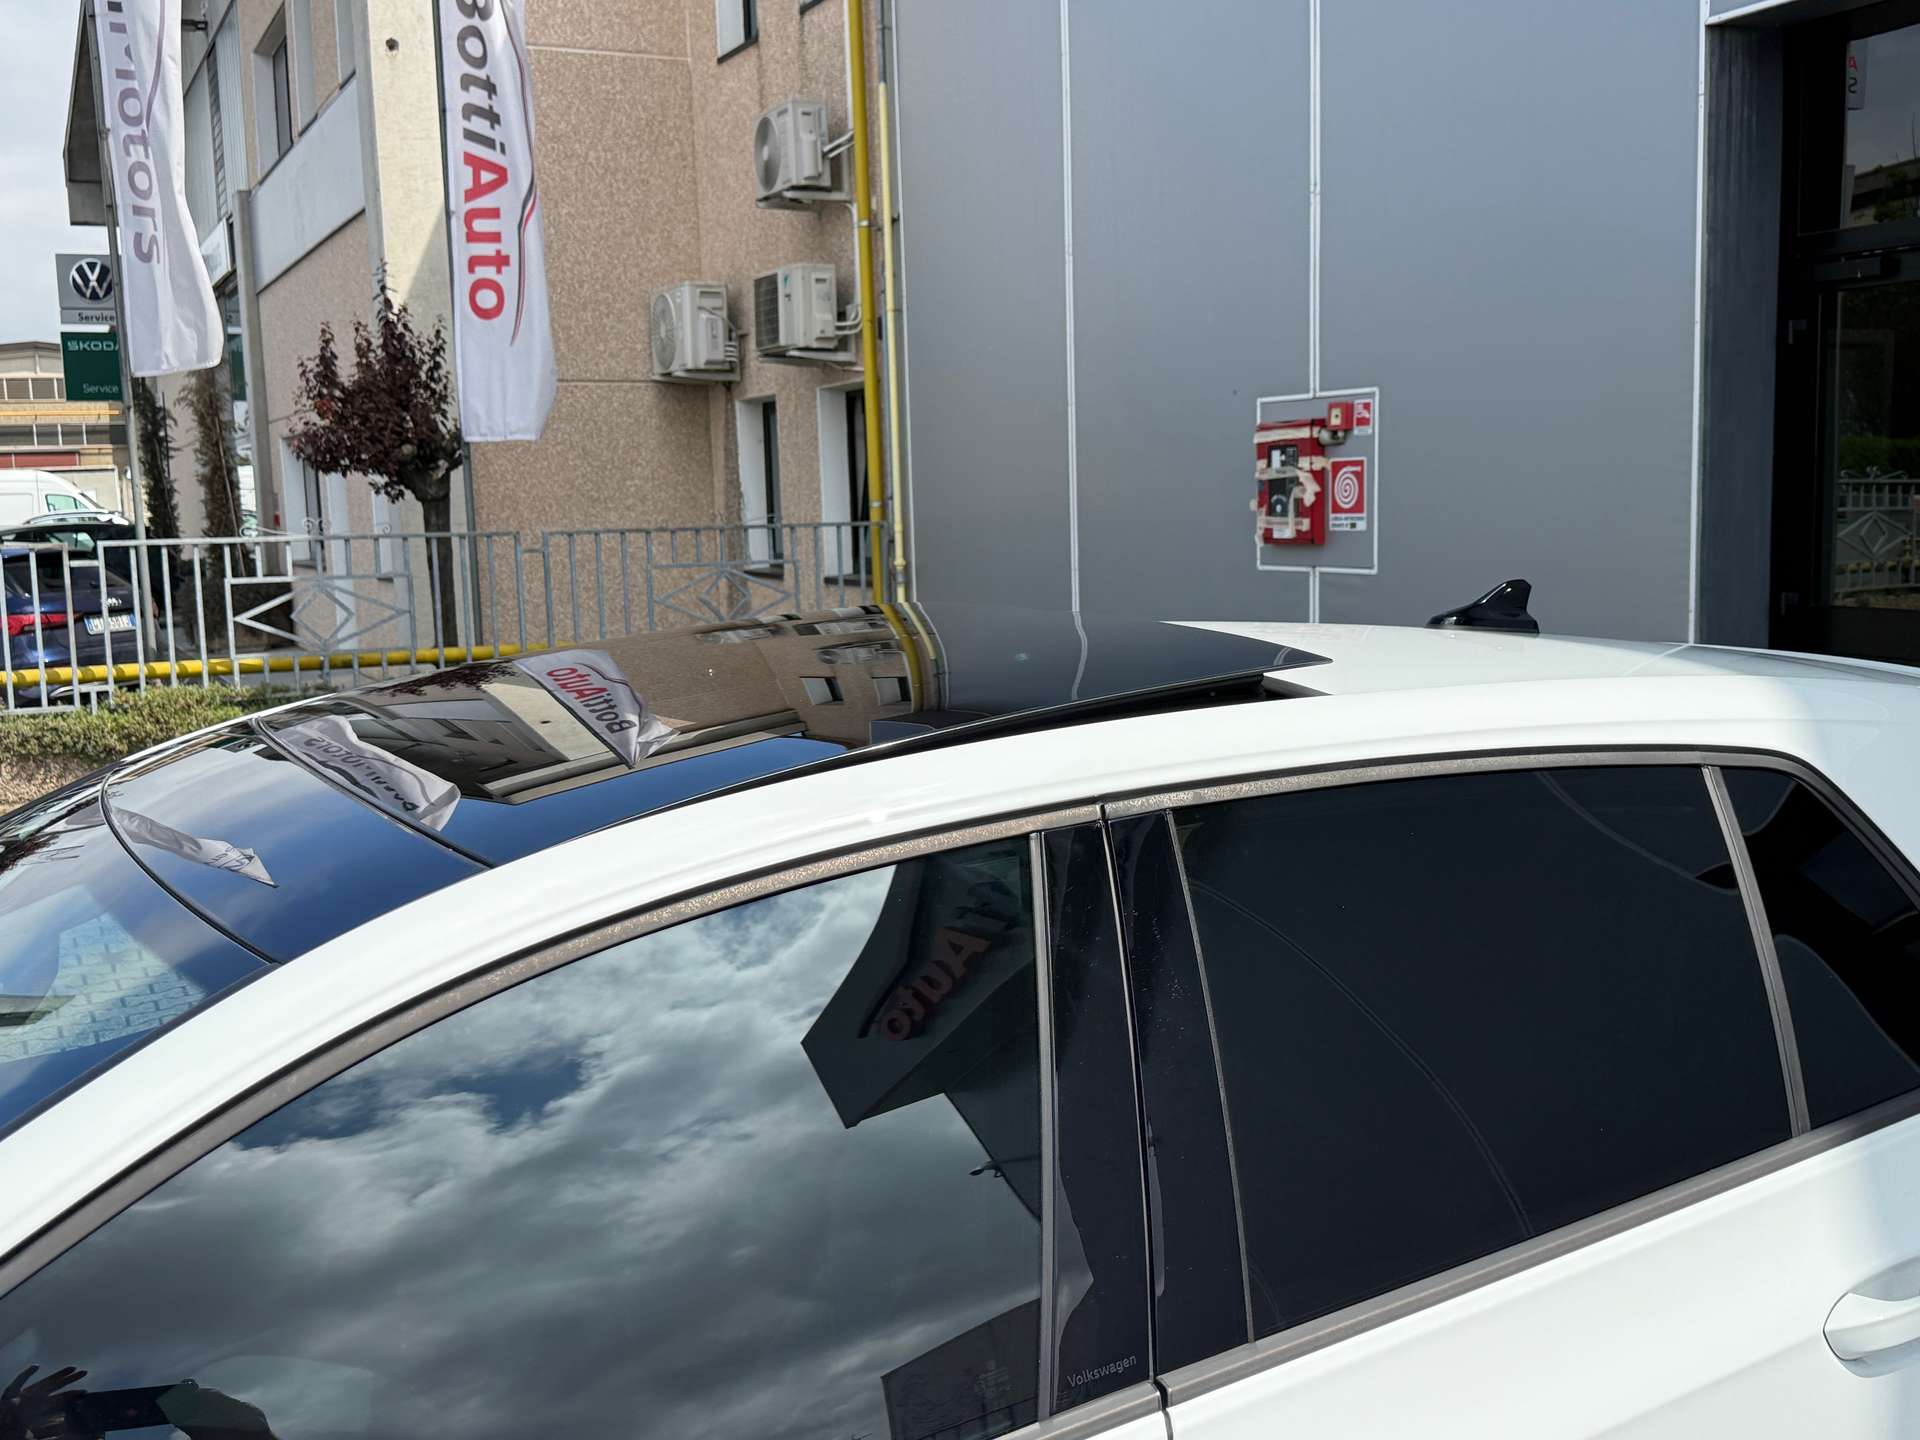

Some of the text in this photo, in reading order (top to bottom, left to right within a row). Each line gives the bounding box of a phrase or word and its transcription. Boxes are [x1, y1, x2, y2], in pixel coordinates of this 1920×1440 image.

[77, 311, 115, 322] Service
[82, 383, 119, 394] Service
[1066, 1355, 1137, 1388] Volkswagen
